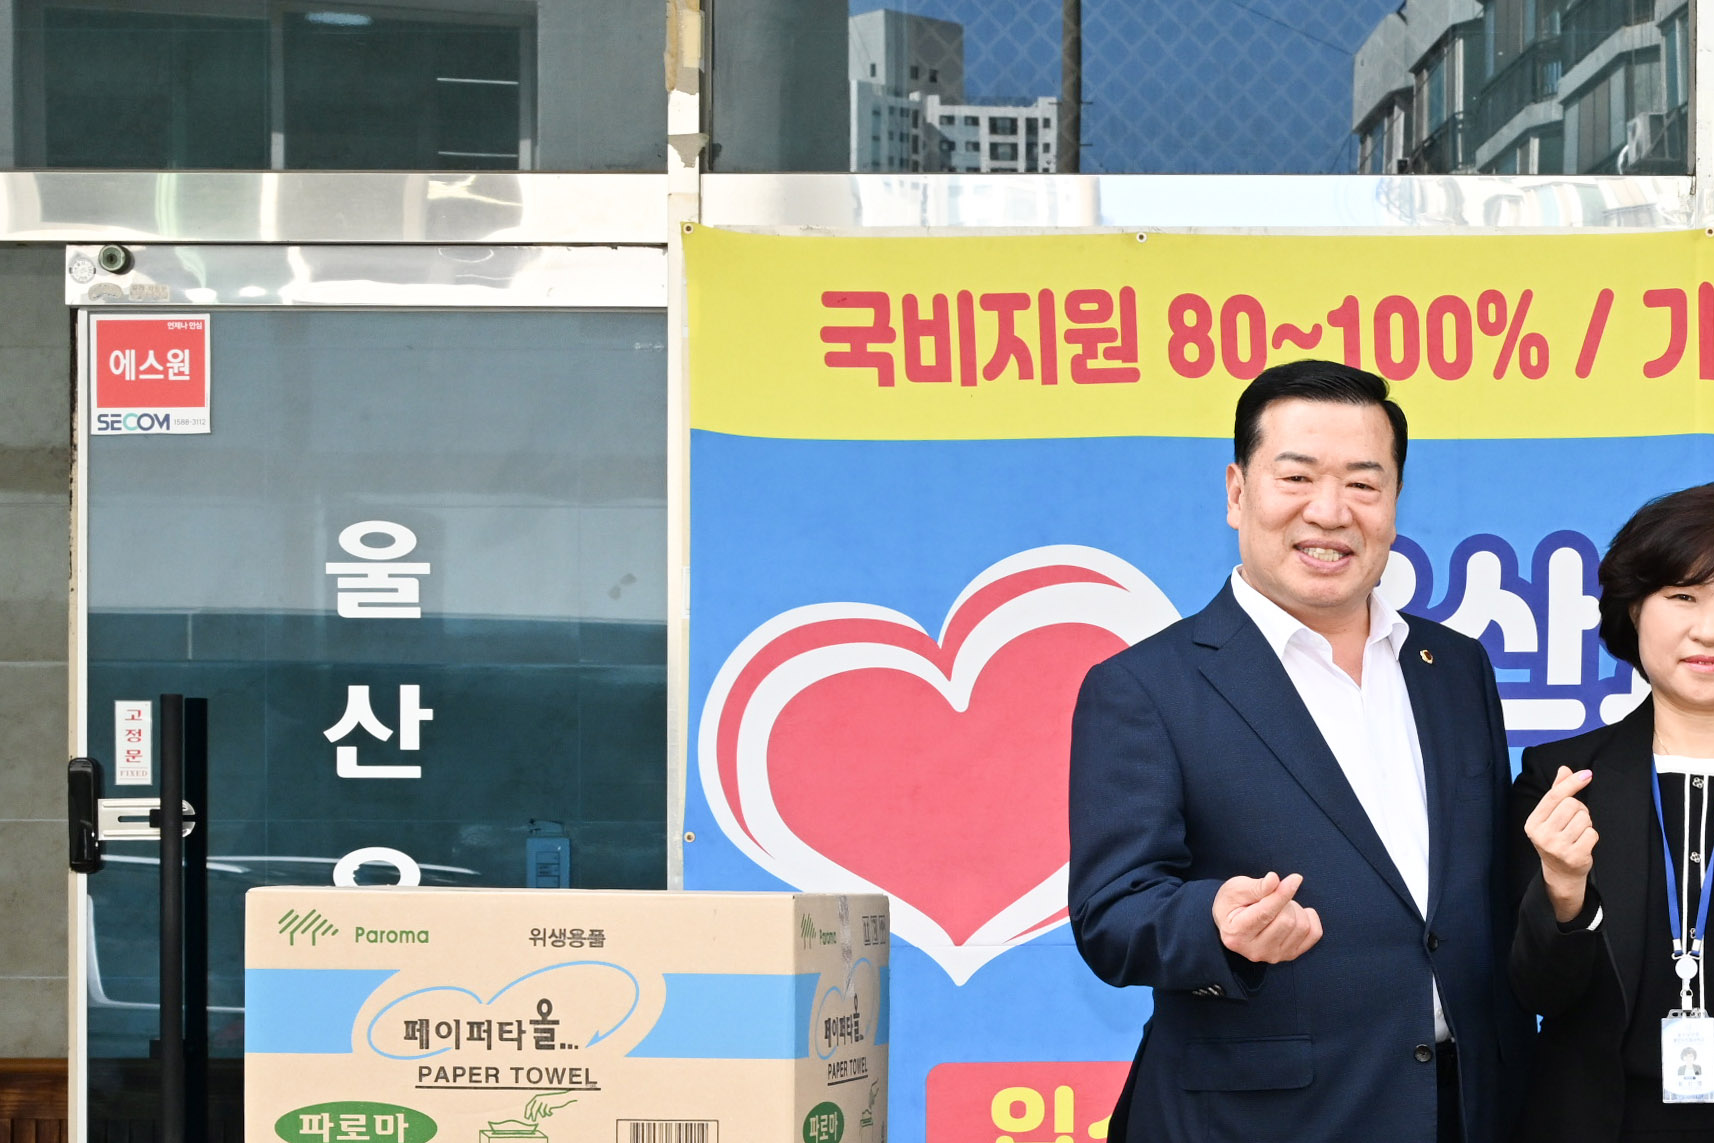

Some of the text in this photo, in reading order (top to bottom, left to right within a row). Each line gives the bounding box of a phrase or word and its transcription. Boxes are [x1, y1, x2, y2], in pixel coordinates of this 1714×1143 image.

[820, 284, 1141, 388] 국비지원
[1167, 287, 1550, 382] 80~100%
[109, 349, 191, 381] 에스원
[97, 413, 207, 431] SECOM 1588-3112
[125, 709, 143, 763] 고정문
[354, 925, 430, 944] Paroma
[528, 927, 607, 949] 위생용품
[417, 1065, 598, 1087] PAPER TOWEL
[299, 1112, 408, 1143] 파로마
[809, 1112, 838, 1143] 파로마
